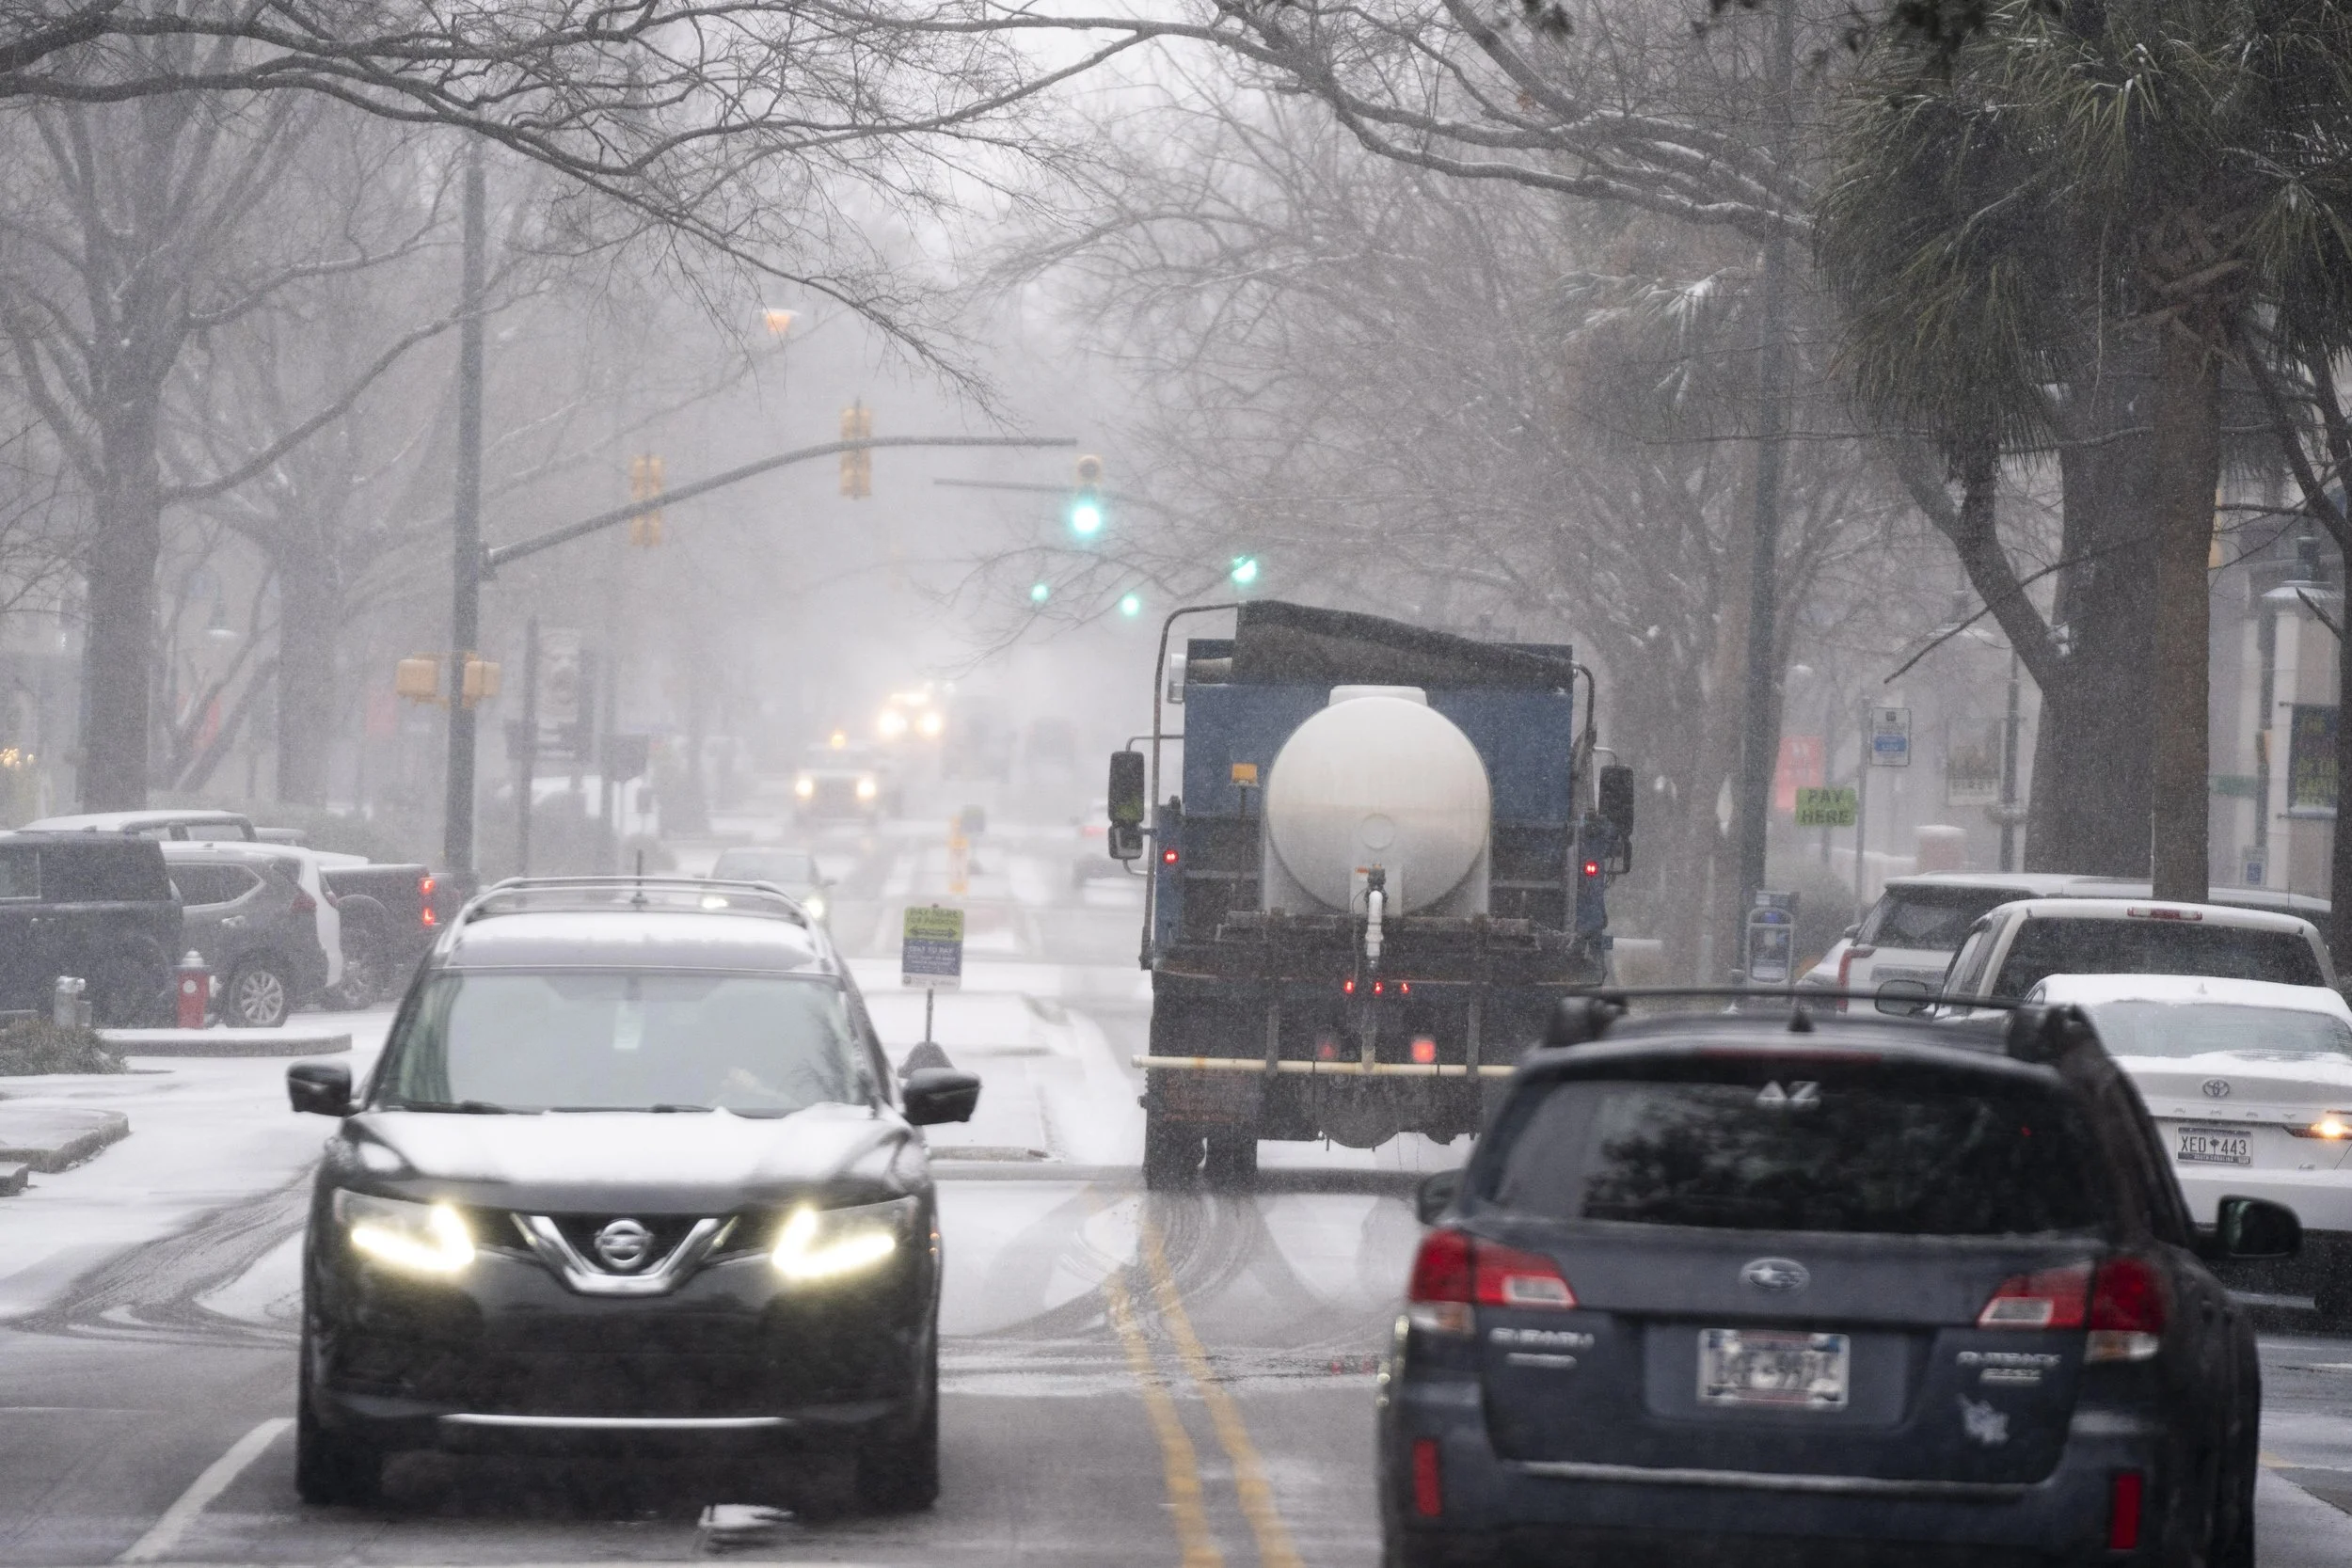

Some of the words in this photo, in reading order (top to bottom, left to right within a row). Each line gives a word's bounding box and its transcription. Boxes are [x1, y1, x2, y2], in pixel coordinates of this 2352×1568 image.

[1807, 788, 1844, 803] PAY
[1802, 809, 1849, 825] HERE
[2181, 1135, 2206, 1153] XED
[2221, 1138, 2247, 1156] 443
